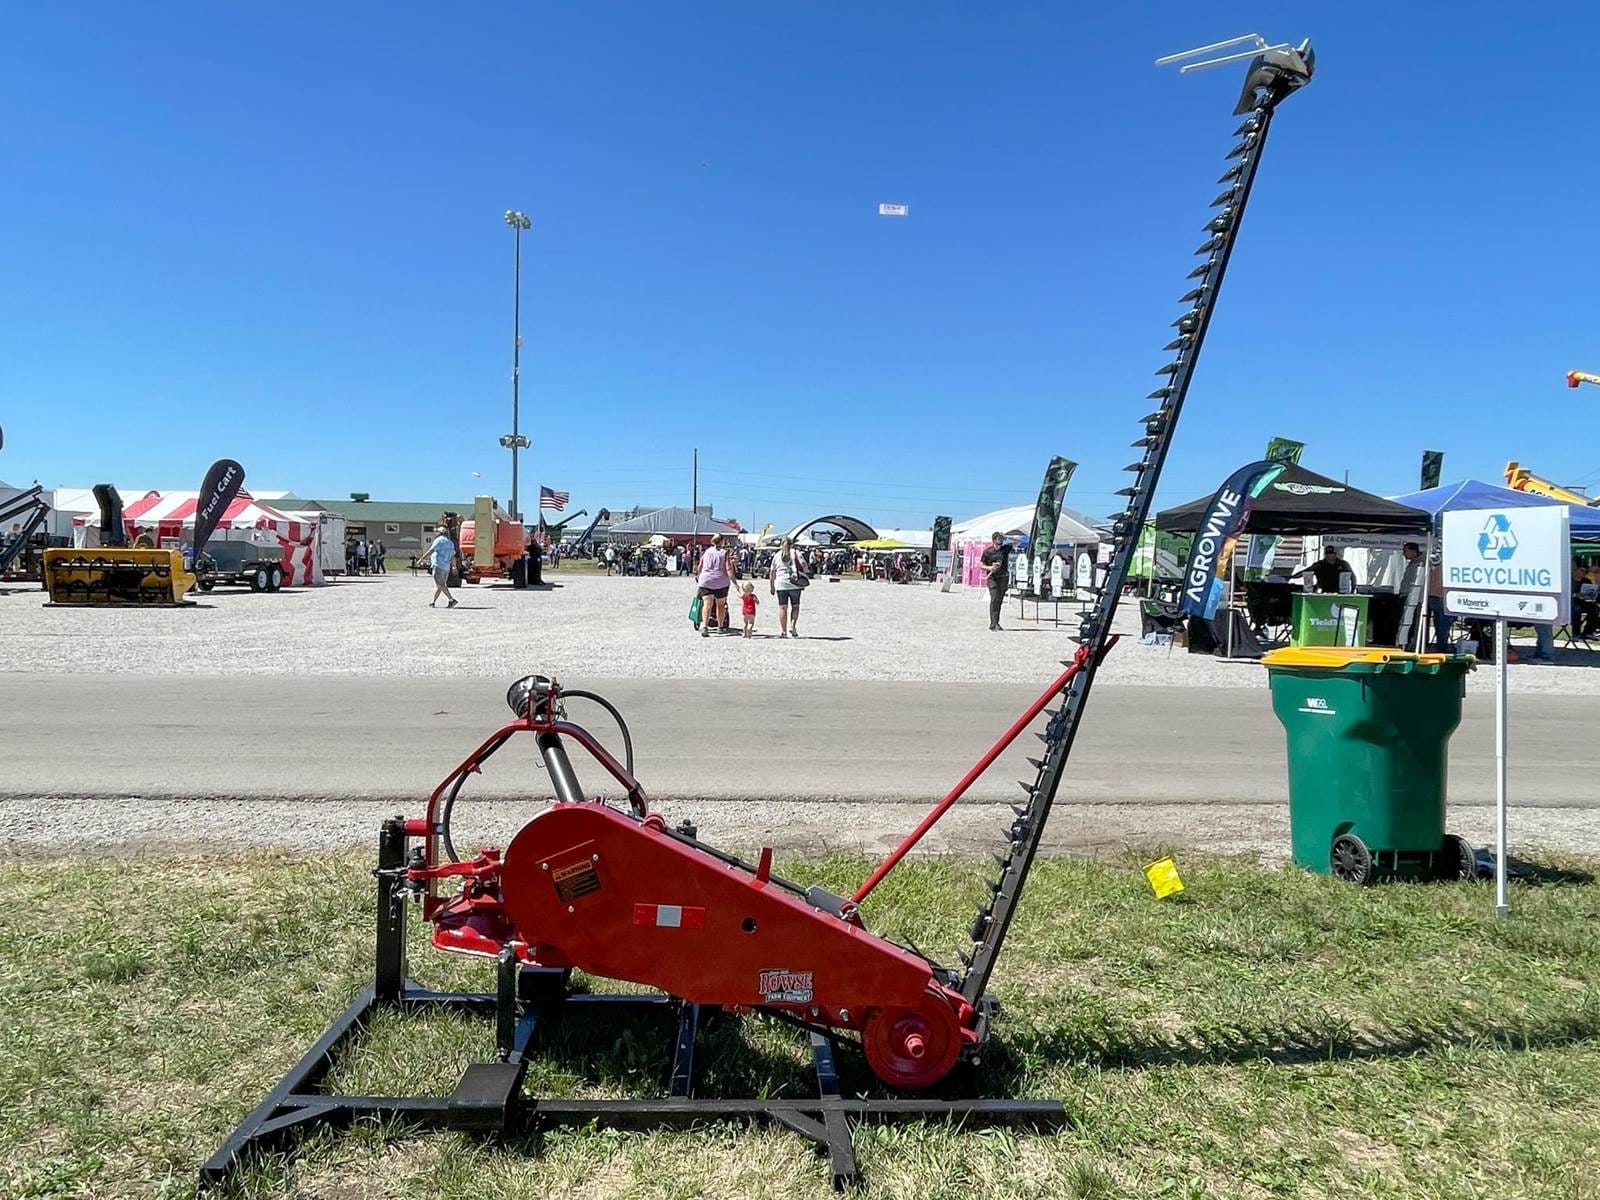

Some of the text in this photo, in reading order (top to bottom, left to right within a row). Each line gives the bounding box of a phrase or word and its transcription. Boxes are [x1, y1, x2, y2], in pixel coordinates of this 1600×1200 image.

[201, 466, 237, 520] Fuel Cart
[1185, 489, 1243, 604] AGROVIVE
[1450, 566, 1552, 588] RECYCLING
